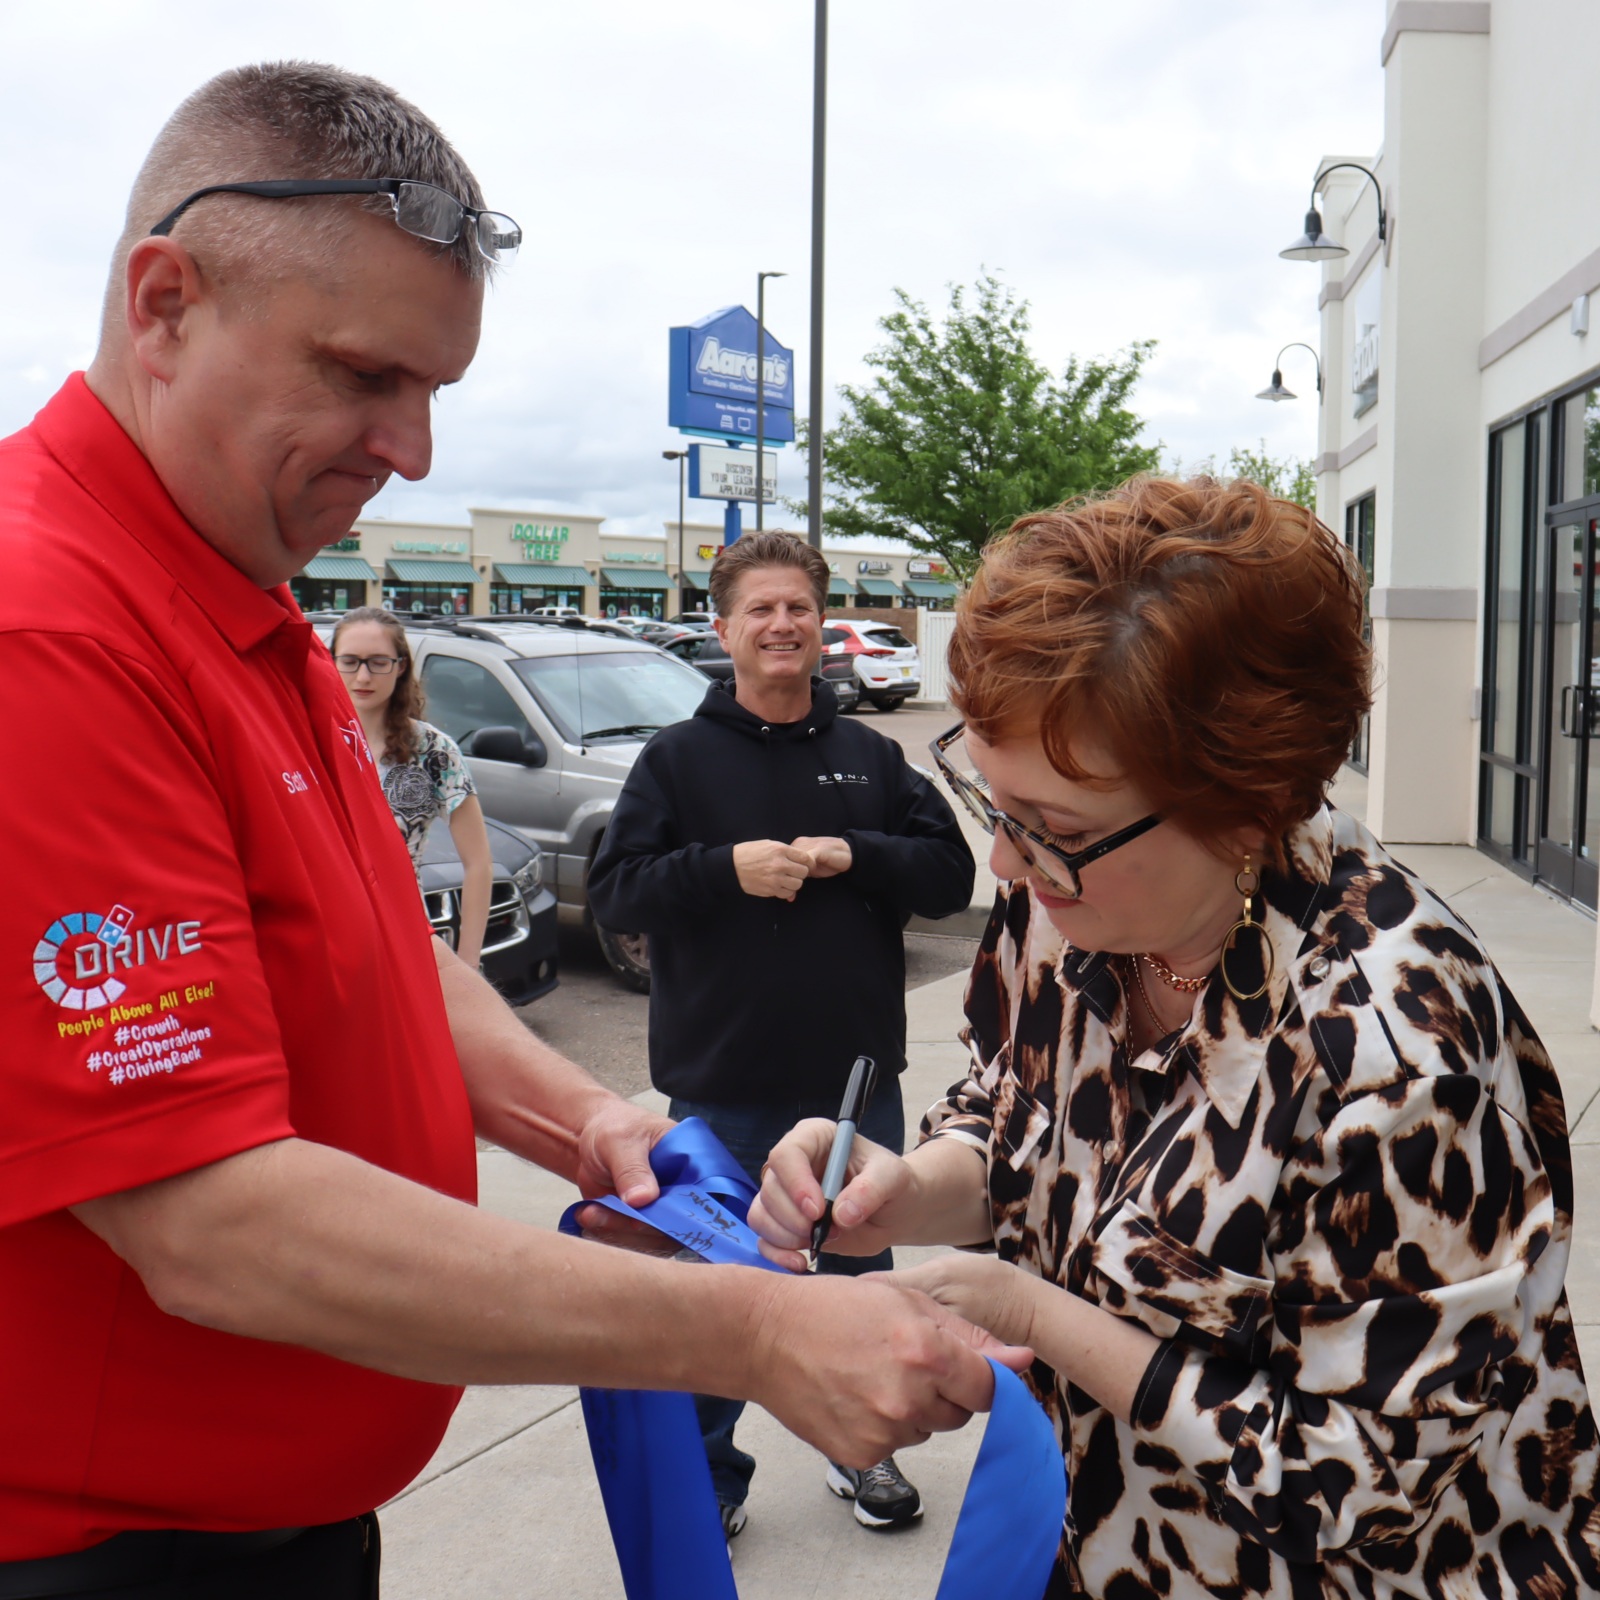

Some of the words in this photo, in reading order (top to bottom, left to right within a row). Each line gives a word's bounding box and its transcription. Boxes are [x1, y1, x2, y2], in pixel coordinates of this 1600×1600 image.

[697, 337, 788, 388] Aaron's
[511, 523, 569, 542] DOLLAR
[523, 543, 561, 561] TREE
[75, 920, 202, 980] DRIVE
[57, 1014, 105, 1038] People
[109, 1002, 154, 1024] Above
[159, 991, 179, 1011] All
[185, 981, 215, 1004] Else!
